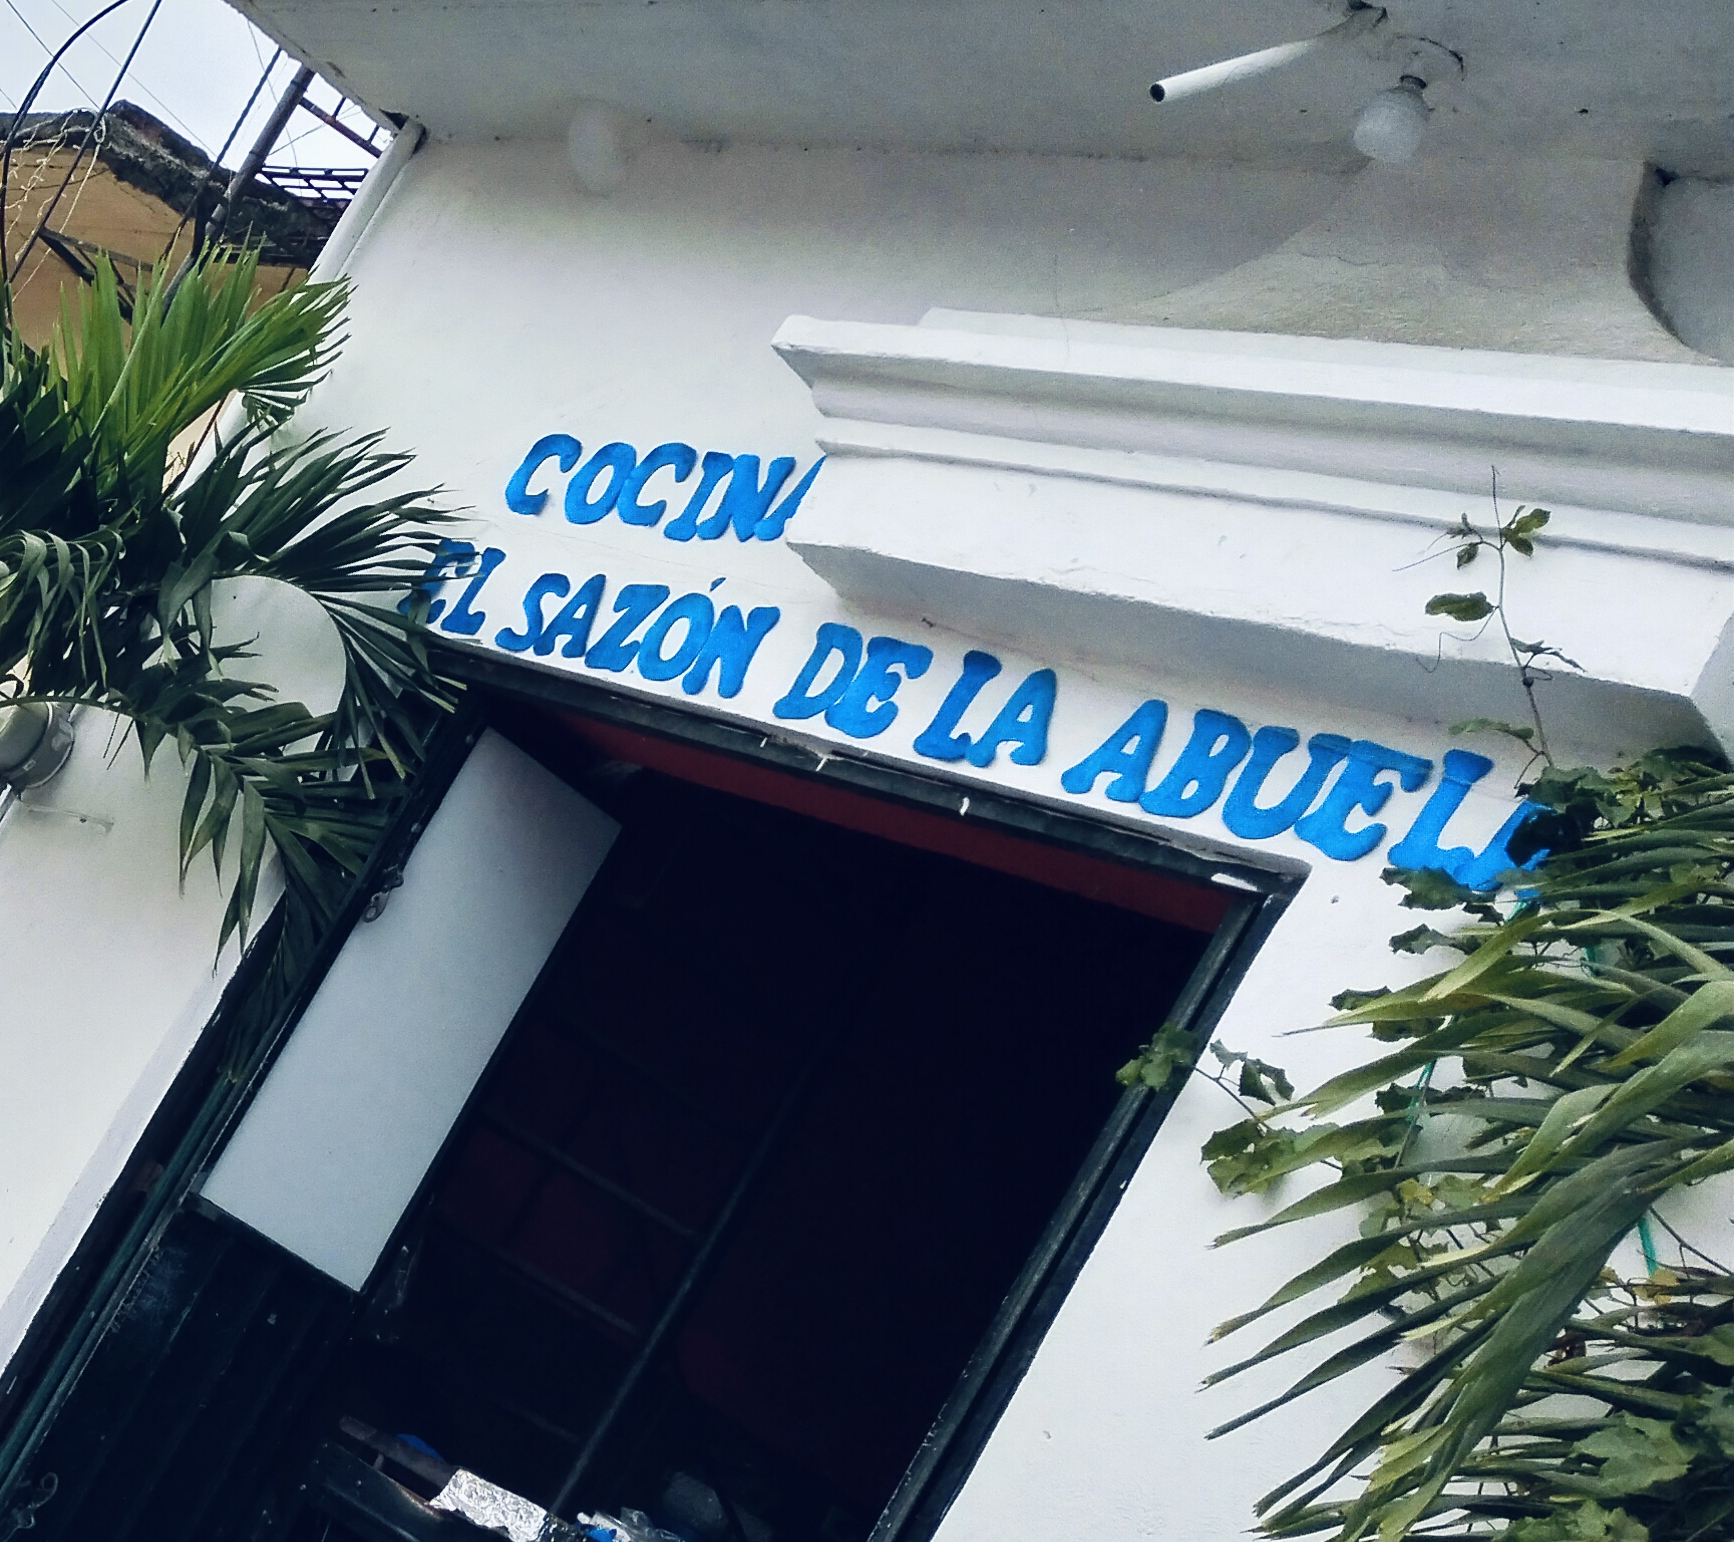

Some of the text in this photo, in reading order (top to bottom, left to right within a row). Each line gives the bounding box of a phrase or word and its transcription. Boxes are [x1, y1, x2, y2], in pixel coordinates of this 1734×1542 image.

[397, 538, 507, 636] EL
[495, 572, 781, 699] SAZÓN
[773, 622, 934, 740] DE
[913, 649, 1057, 768] LA
